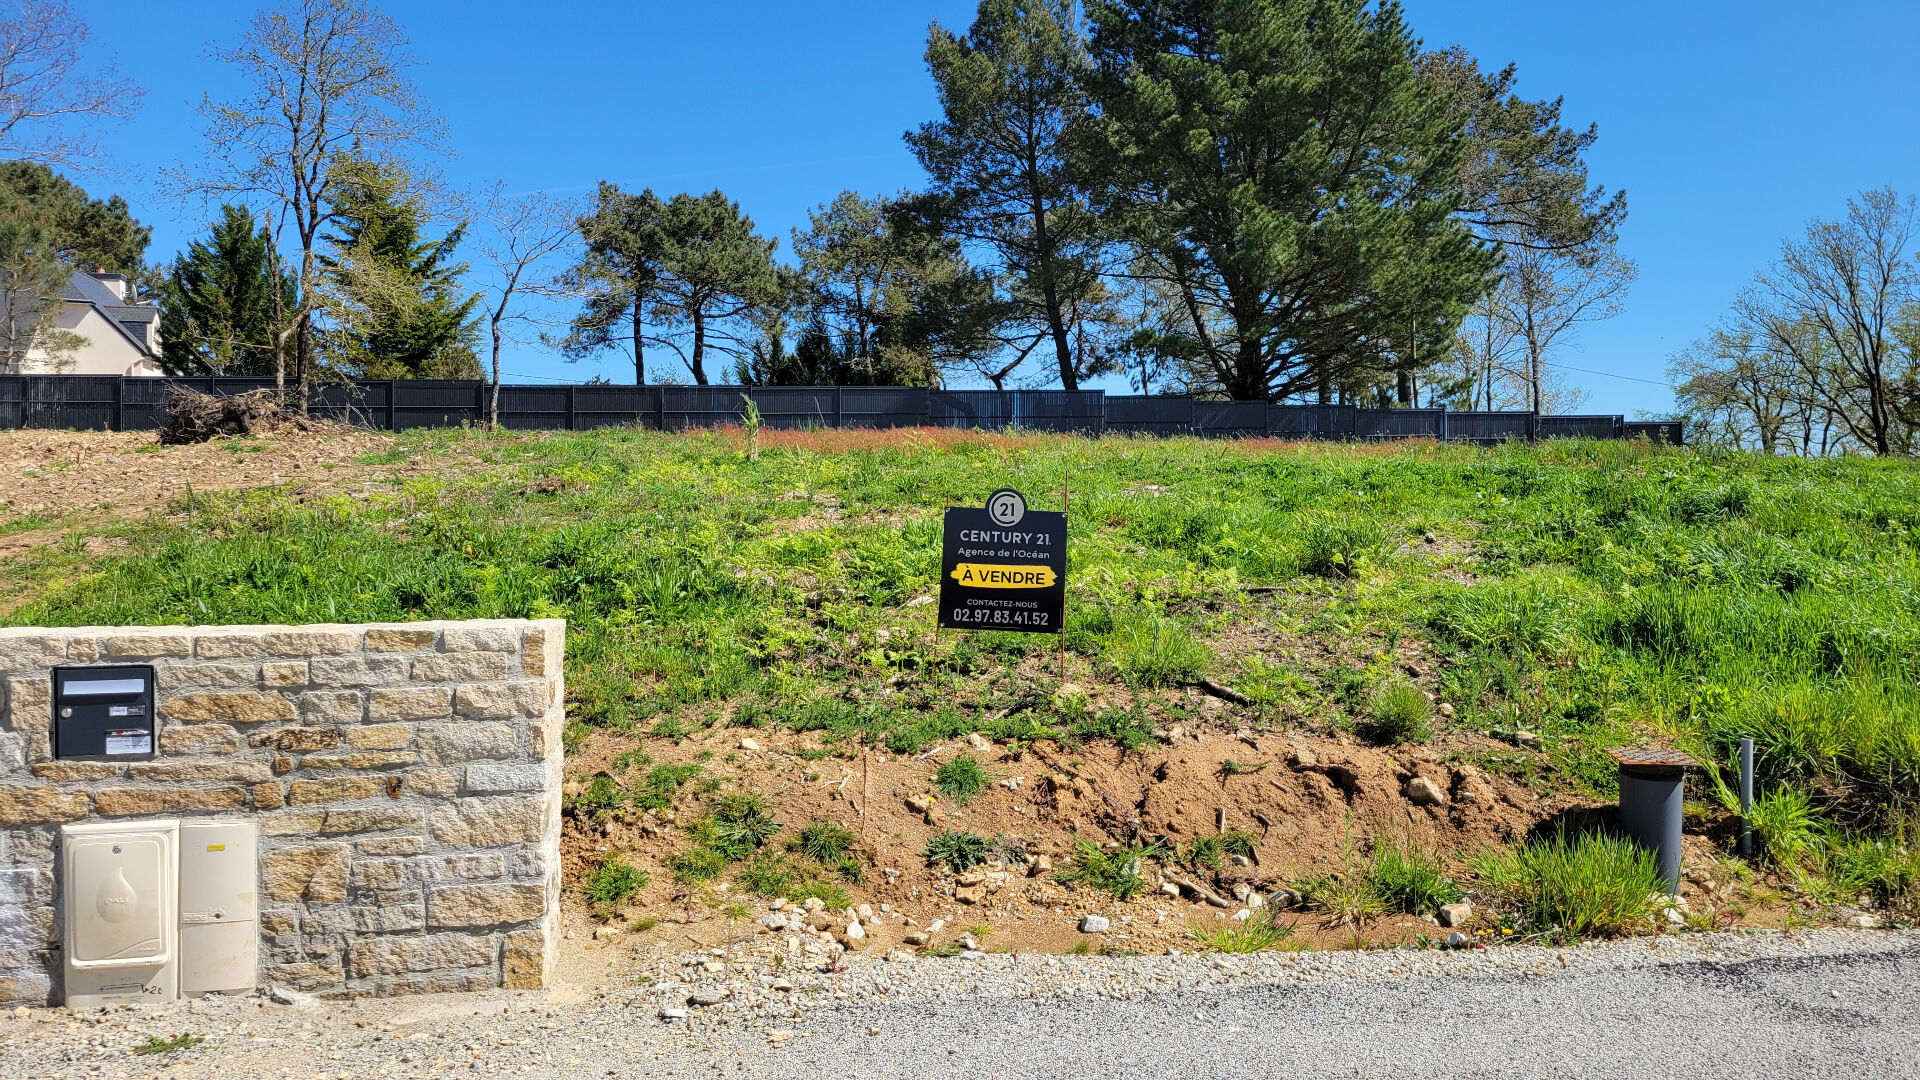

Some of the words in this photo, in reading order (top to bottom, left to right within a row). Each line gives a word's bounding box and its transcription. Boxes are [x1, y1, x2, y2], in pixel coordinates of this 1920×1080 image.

[960, 530, 1033, 544] CENTURY
[1036, 533, 1051, 545] 21
[957, 547, 995, 558] Agence
[997, 549, 1010, 557] de
[1012, 549, 1050, 559] l'Océan
[962, 565, 974, 582] À
[978, 569, 1046, 585] VENDRE
[966, 598, 1038, 609] CONTACTEZ-NOUS
[953, 608, 1049, 626] 02.97.83.41.52
